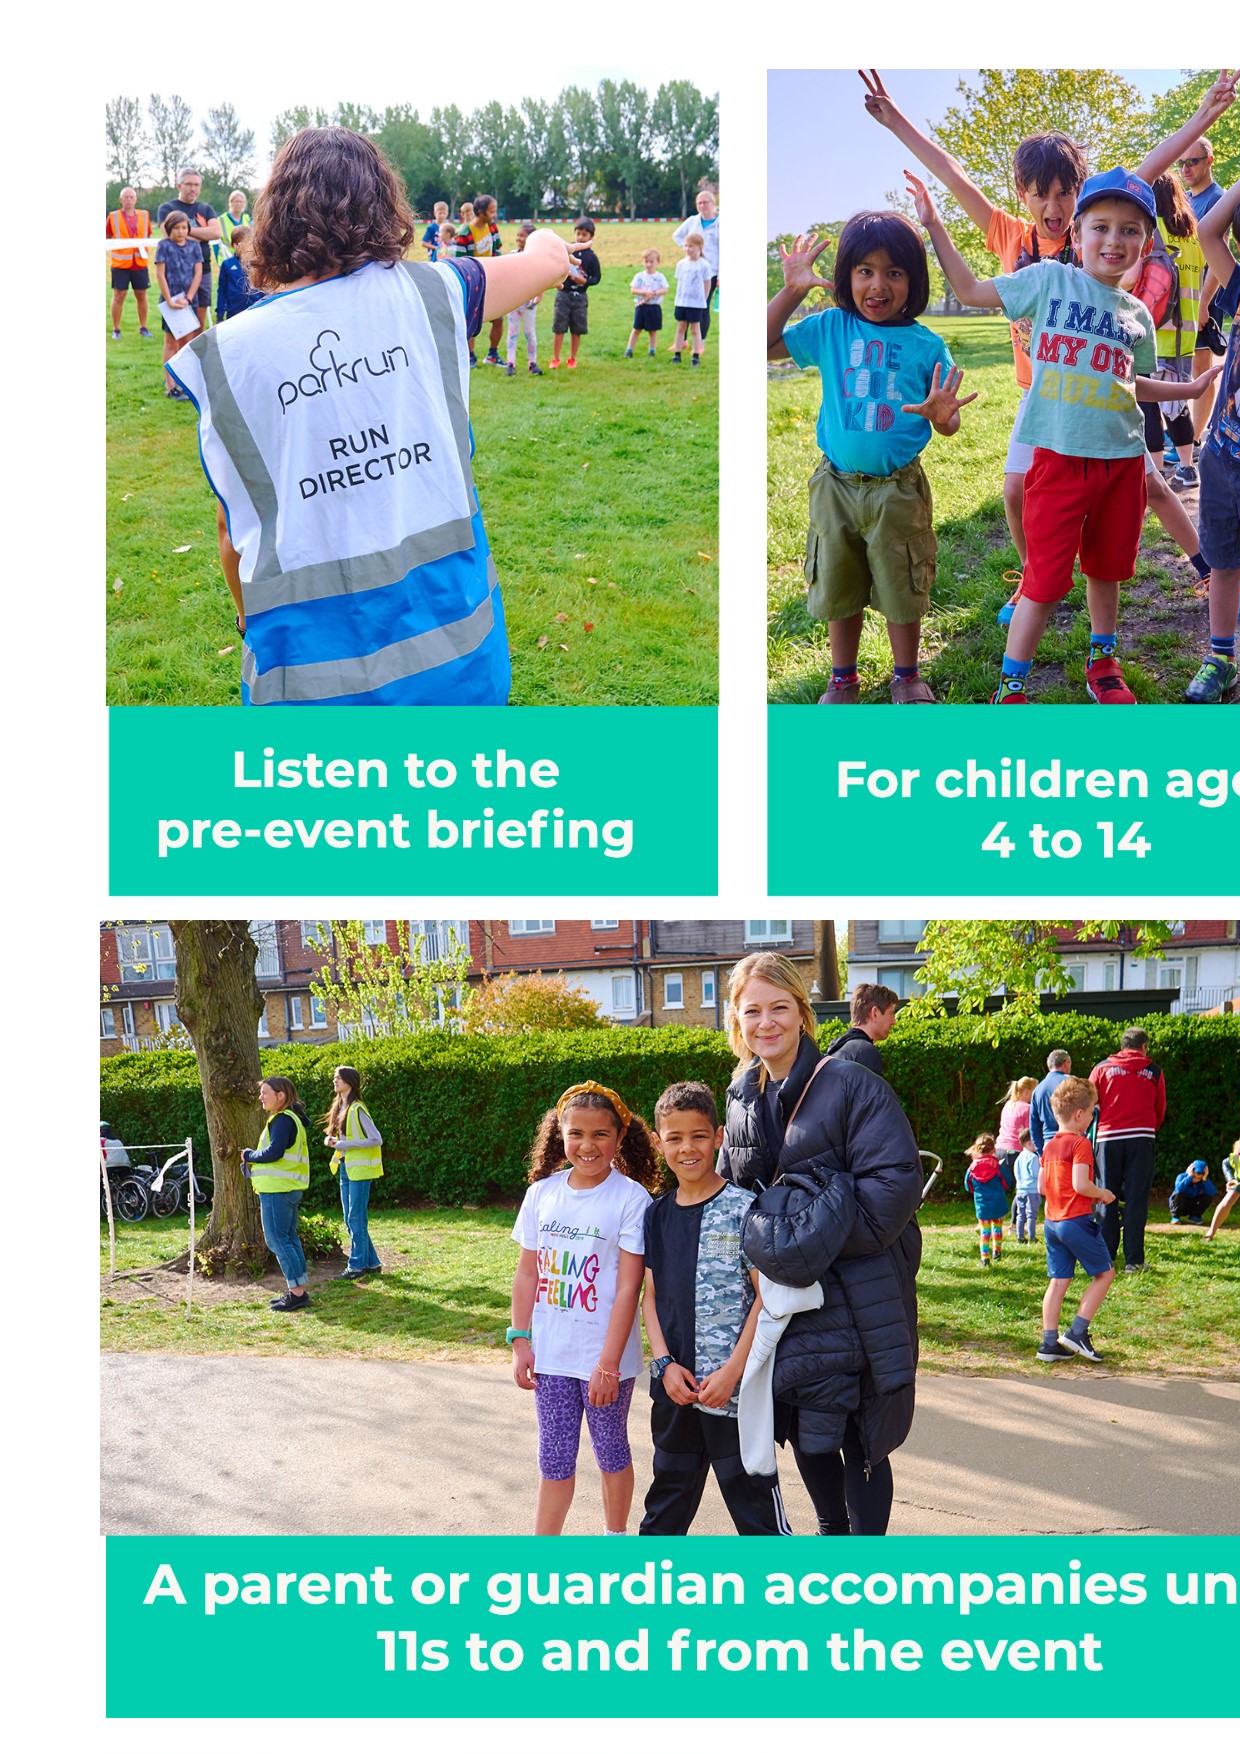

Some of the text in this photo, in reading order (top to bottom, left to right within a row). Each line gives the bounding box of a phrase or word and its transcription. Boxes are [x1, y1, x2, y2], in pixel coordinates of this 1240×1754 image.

[1046, 299, 1062, 327] I
[849, 339, 903, 370] ONE
[1037, 332, 1088, 367] MY
[278, 330, 409, 415] parkrun
[842, 367, 903, 401] COOL
[844, 401, 896, 432] KID
[329, 424, 390, 460] RUN
[299, 442, 433, 500] DIRECTOR
[234, 747, 559, 788] Listen to the
[838, 761, 920, 798] For
[935, 757, 1148, 798] children
[158, 807, 633, 858] pre-event briefing
[981, 821, 1151, 858] 4 to 14
[536, 1278, 598, 1313] FEELING
[143, 1564, 187, 1604] A
[205, 1566, 394, 1615] parent
[411, 1573, 470, 1605] or
[487, 1559, 744, 1615] guardian
[764, 1559, 1147, 1615] accompanies
[376, 1628, 1103, 1671] 11s to and from the event
